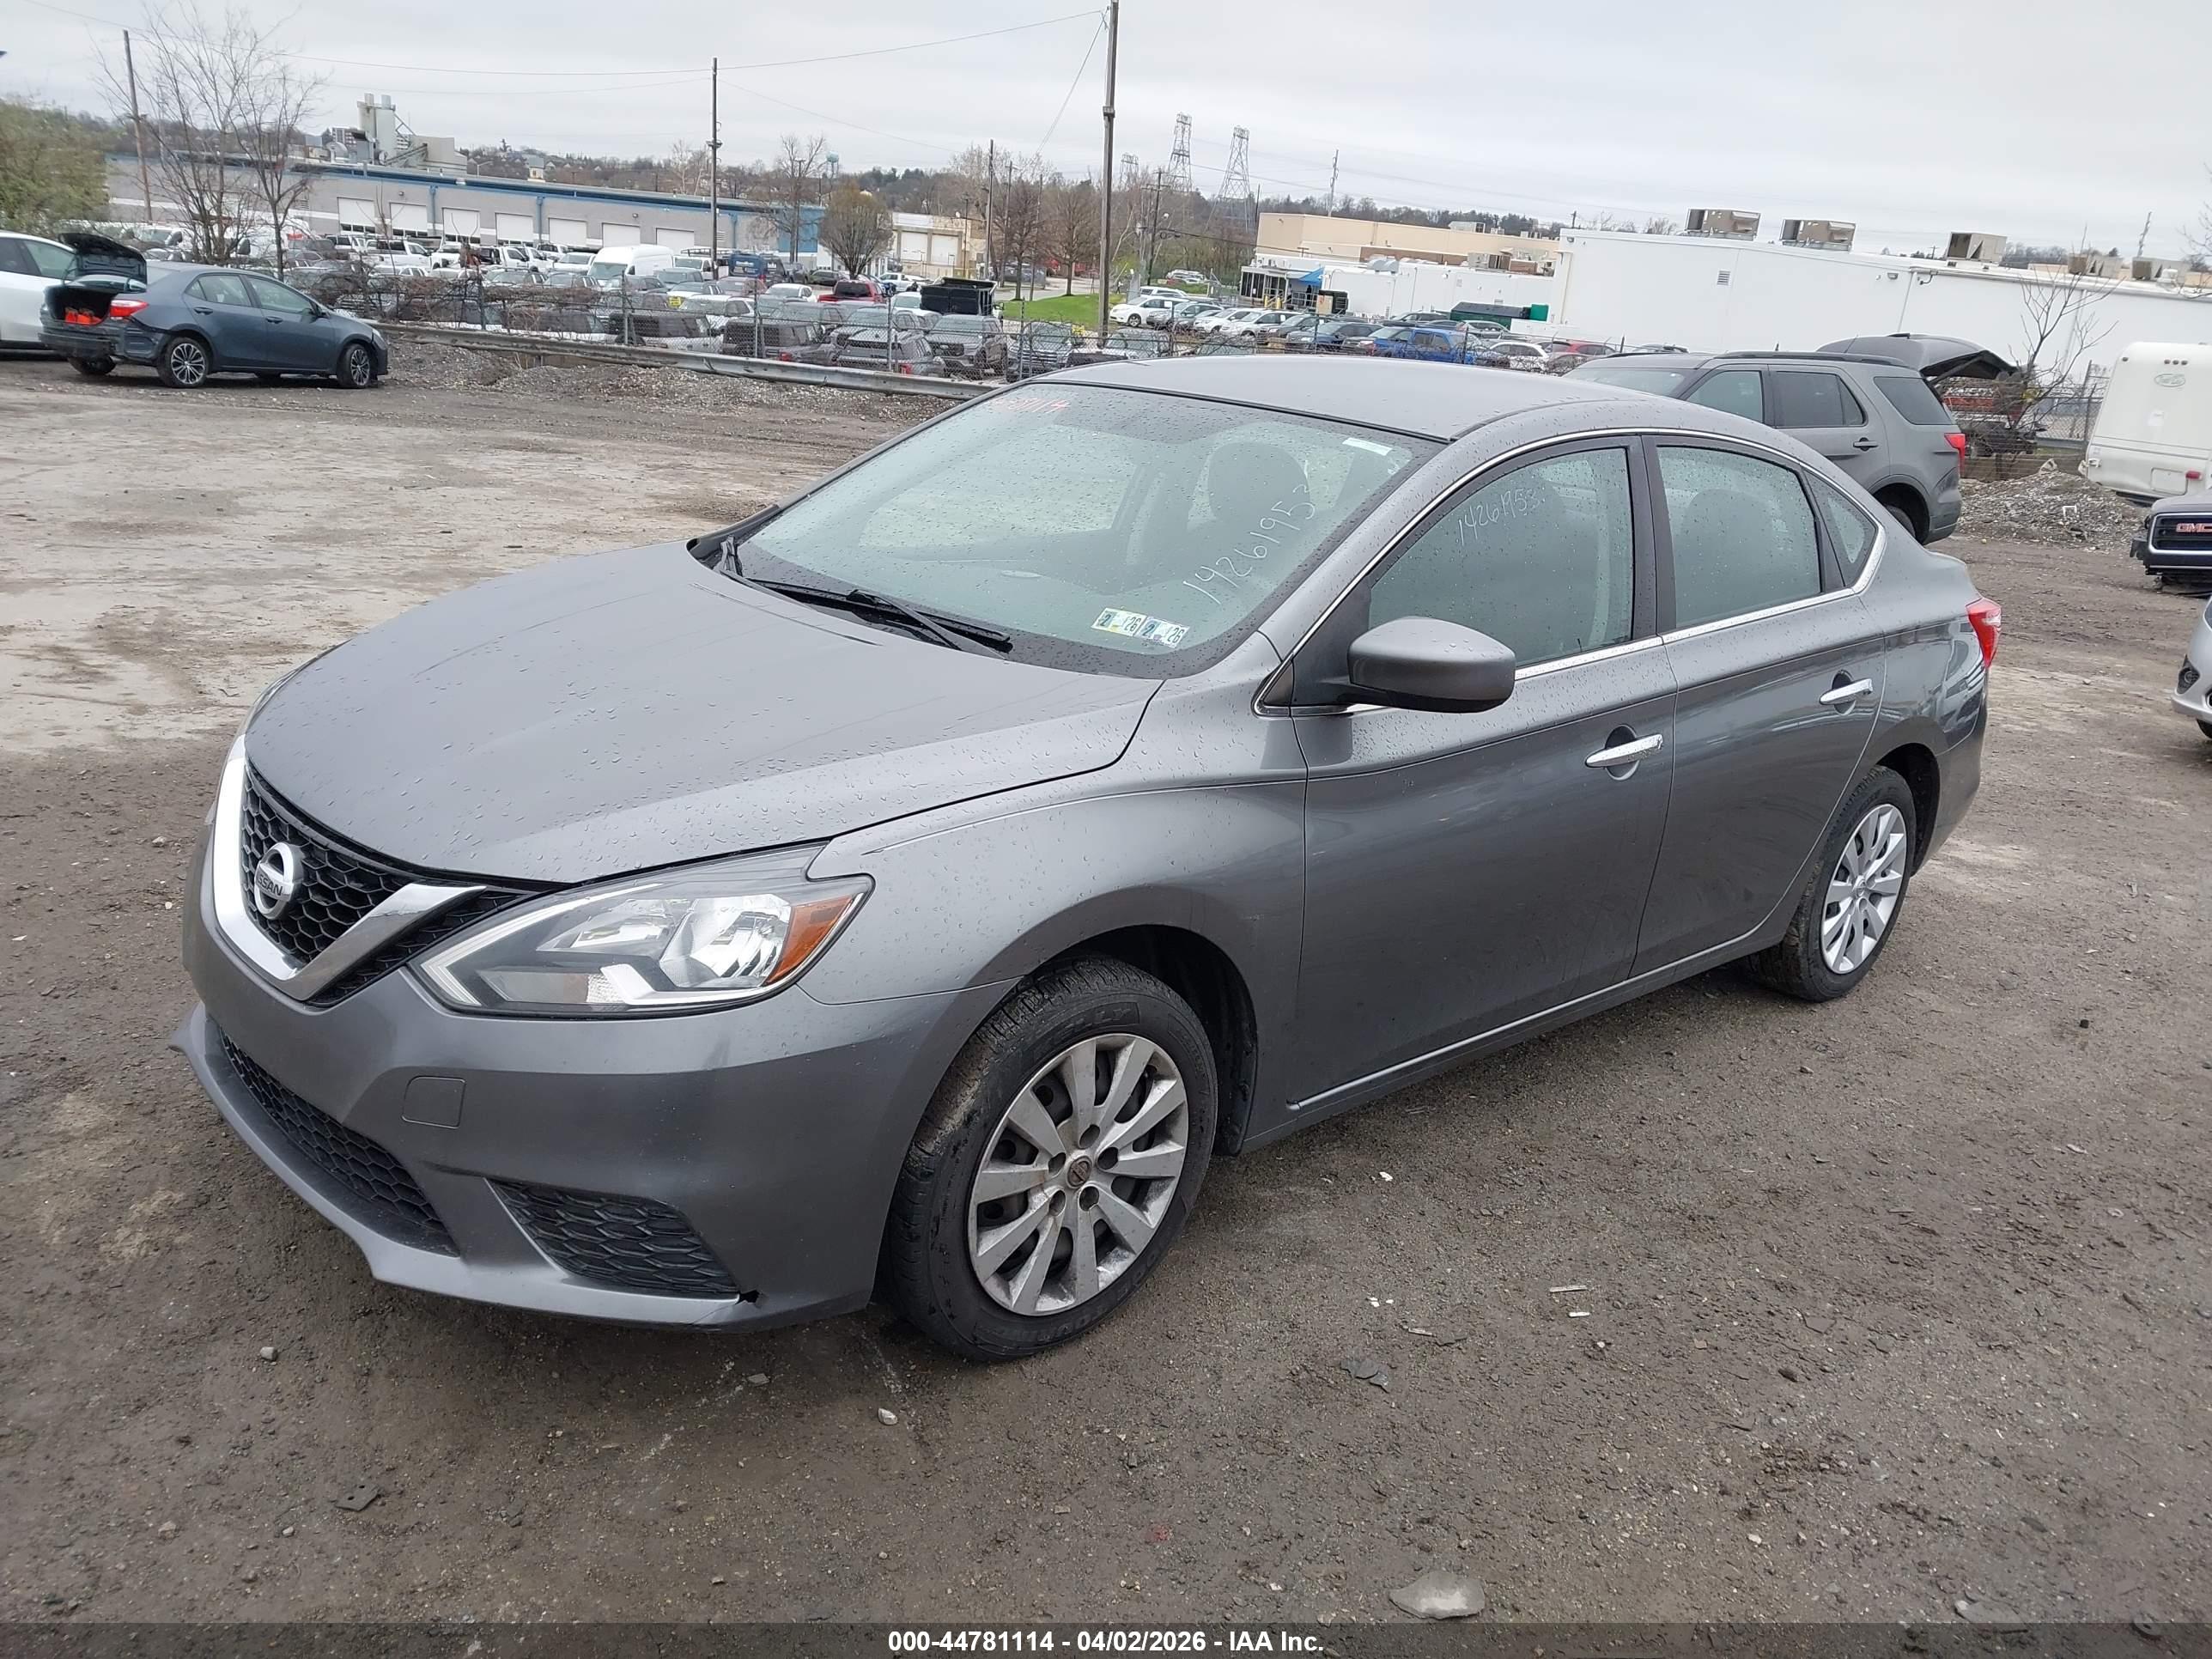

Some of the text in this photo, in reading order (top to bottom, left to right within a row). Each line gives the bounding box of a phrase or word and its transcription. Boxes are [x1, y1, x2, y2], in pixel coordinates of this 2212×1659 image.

[1457, 488, 1541, 548] 14261953
[2176, 522, 2212, 533] GMC
[1100, 613, 1112, 627] 2
[1142, 623, 1156, 637] 2
[257, 872, 283, 896] SSAN
